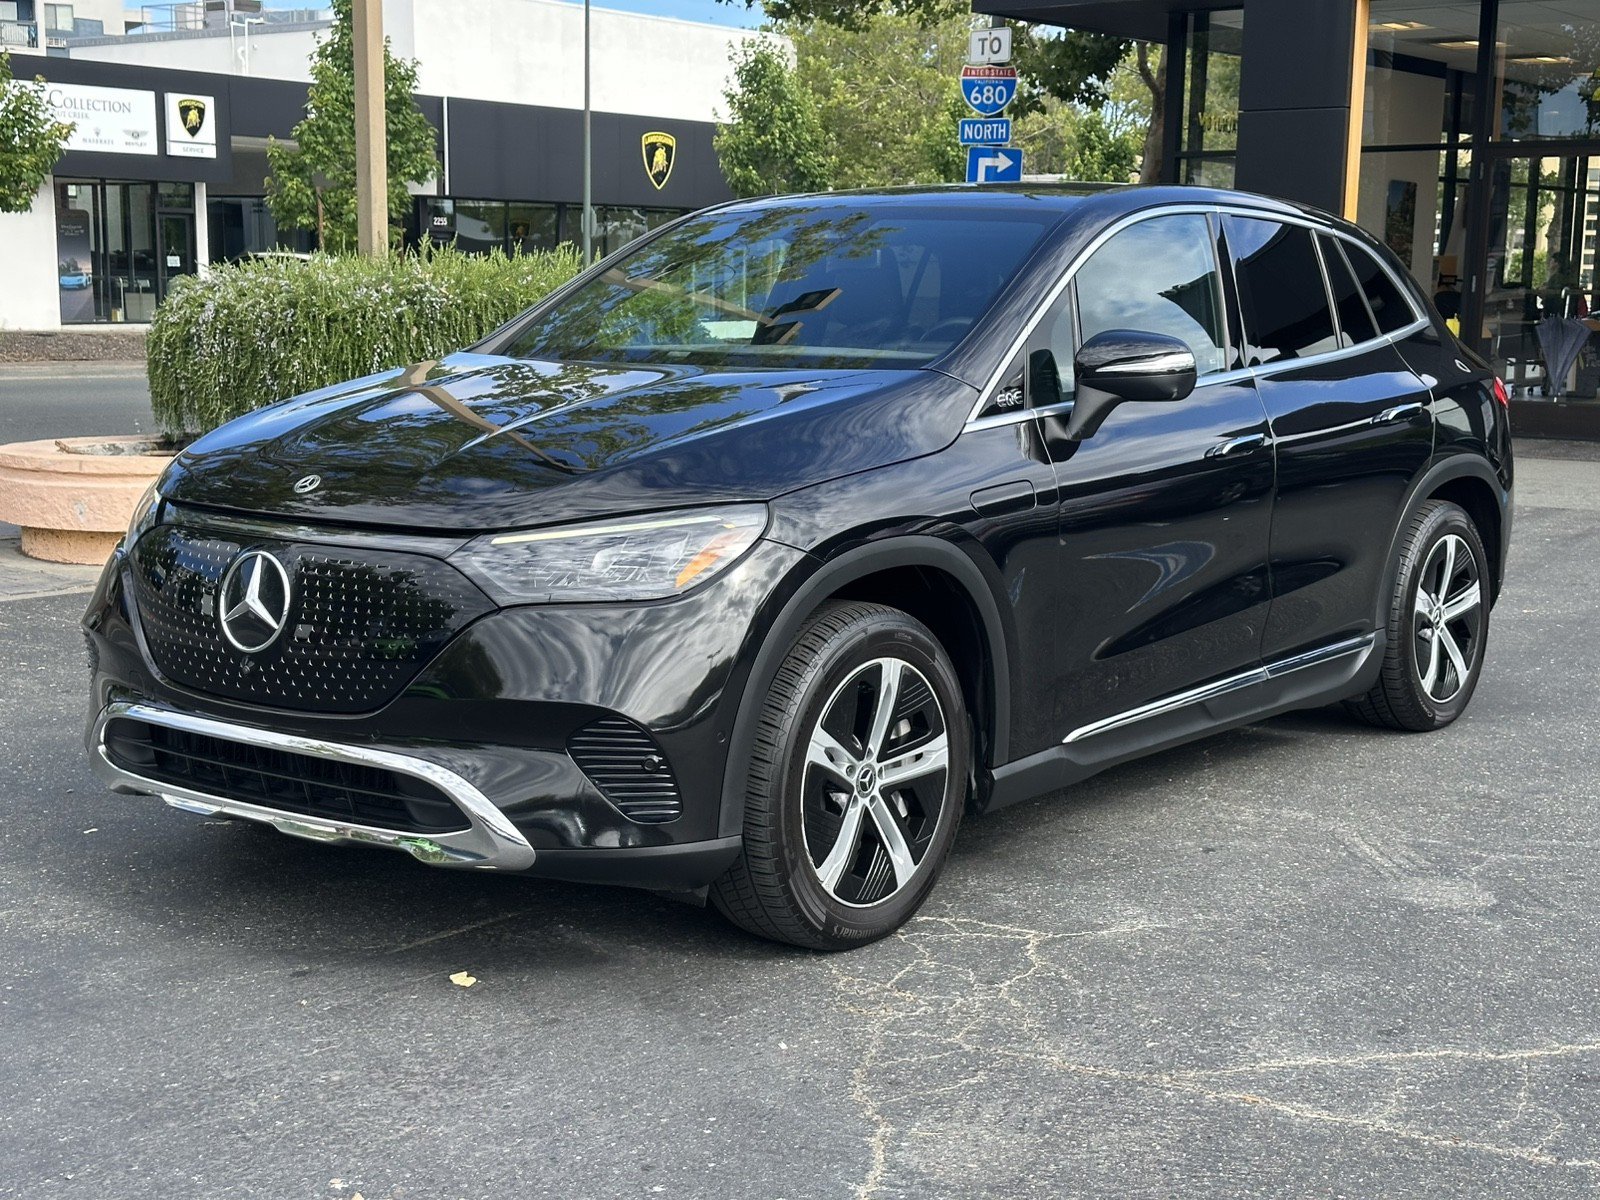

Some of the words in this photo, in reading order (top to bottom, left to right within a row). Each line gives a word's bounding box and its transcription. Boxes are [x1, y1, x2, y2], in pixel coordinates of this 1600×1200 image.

[978, 36, 1002, 55] TO
[967, 69, 1012, 77] INTERSTATE
[970, 86, 1007, 105] 680
[68, 111, 90, 119] CREEK
[964, 123, 1006, 139] NORTH
[433, 216, 448, 225] 2255
